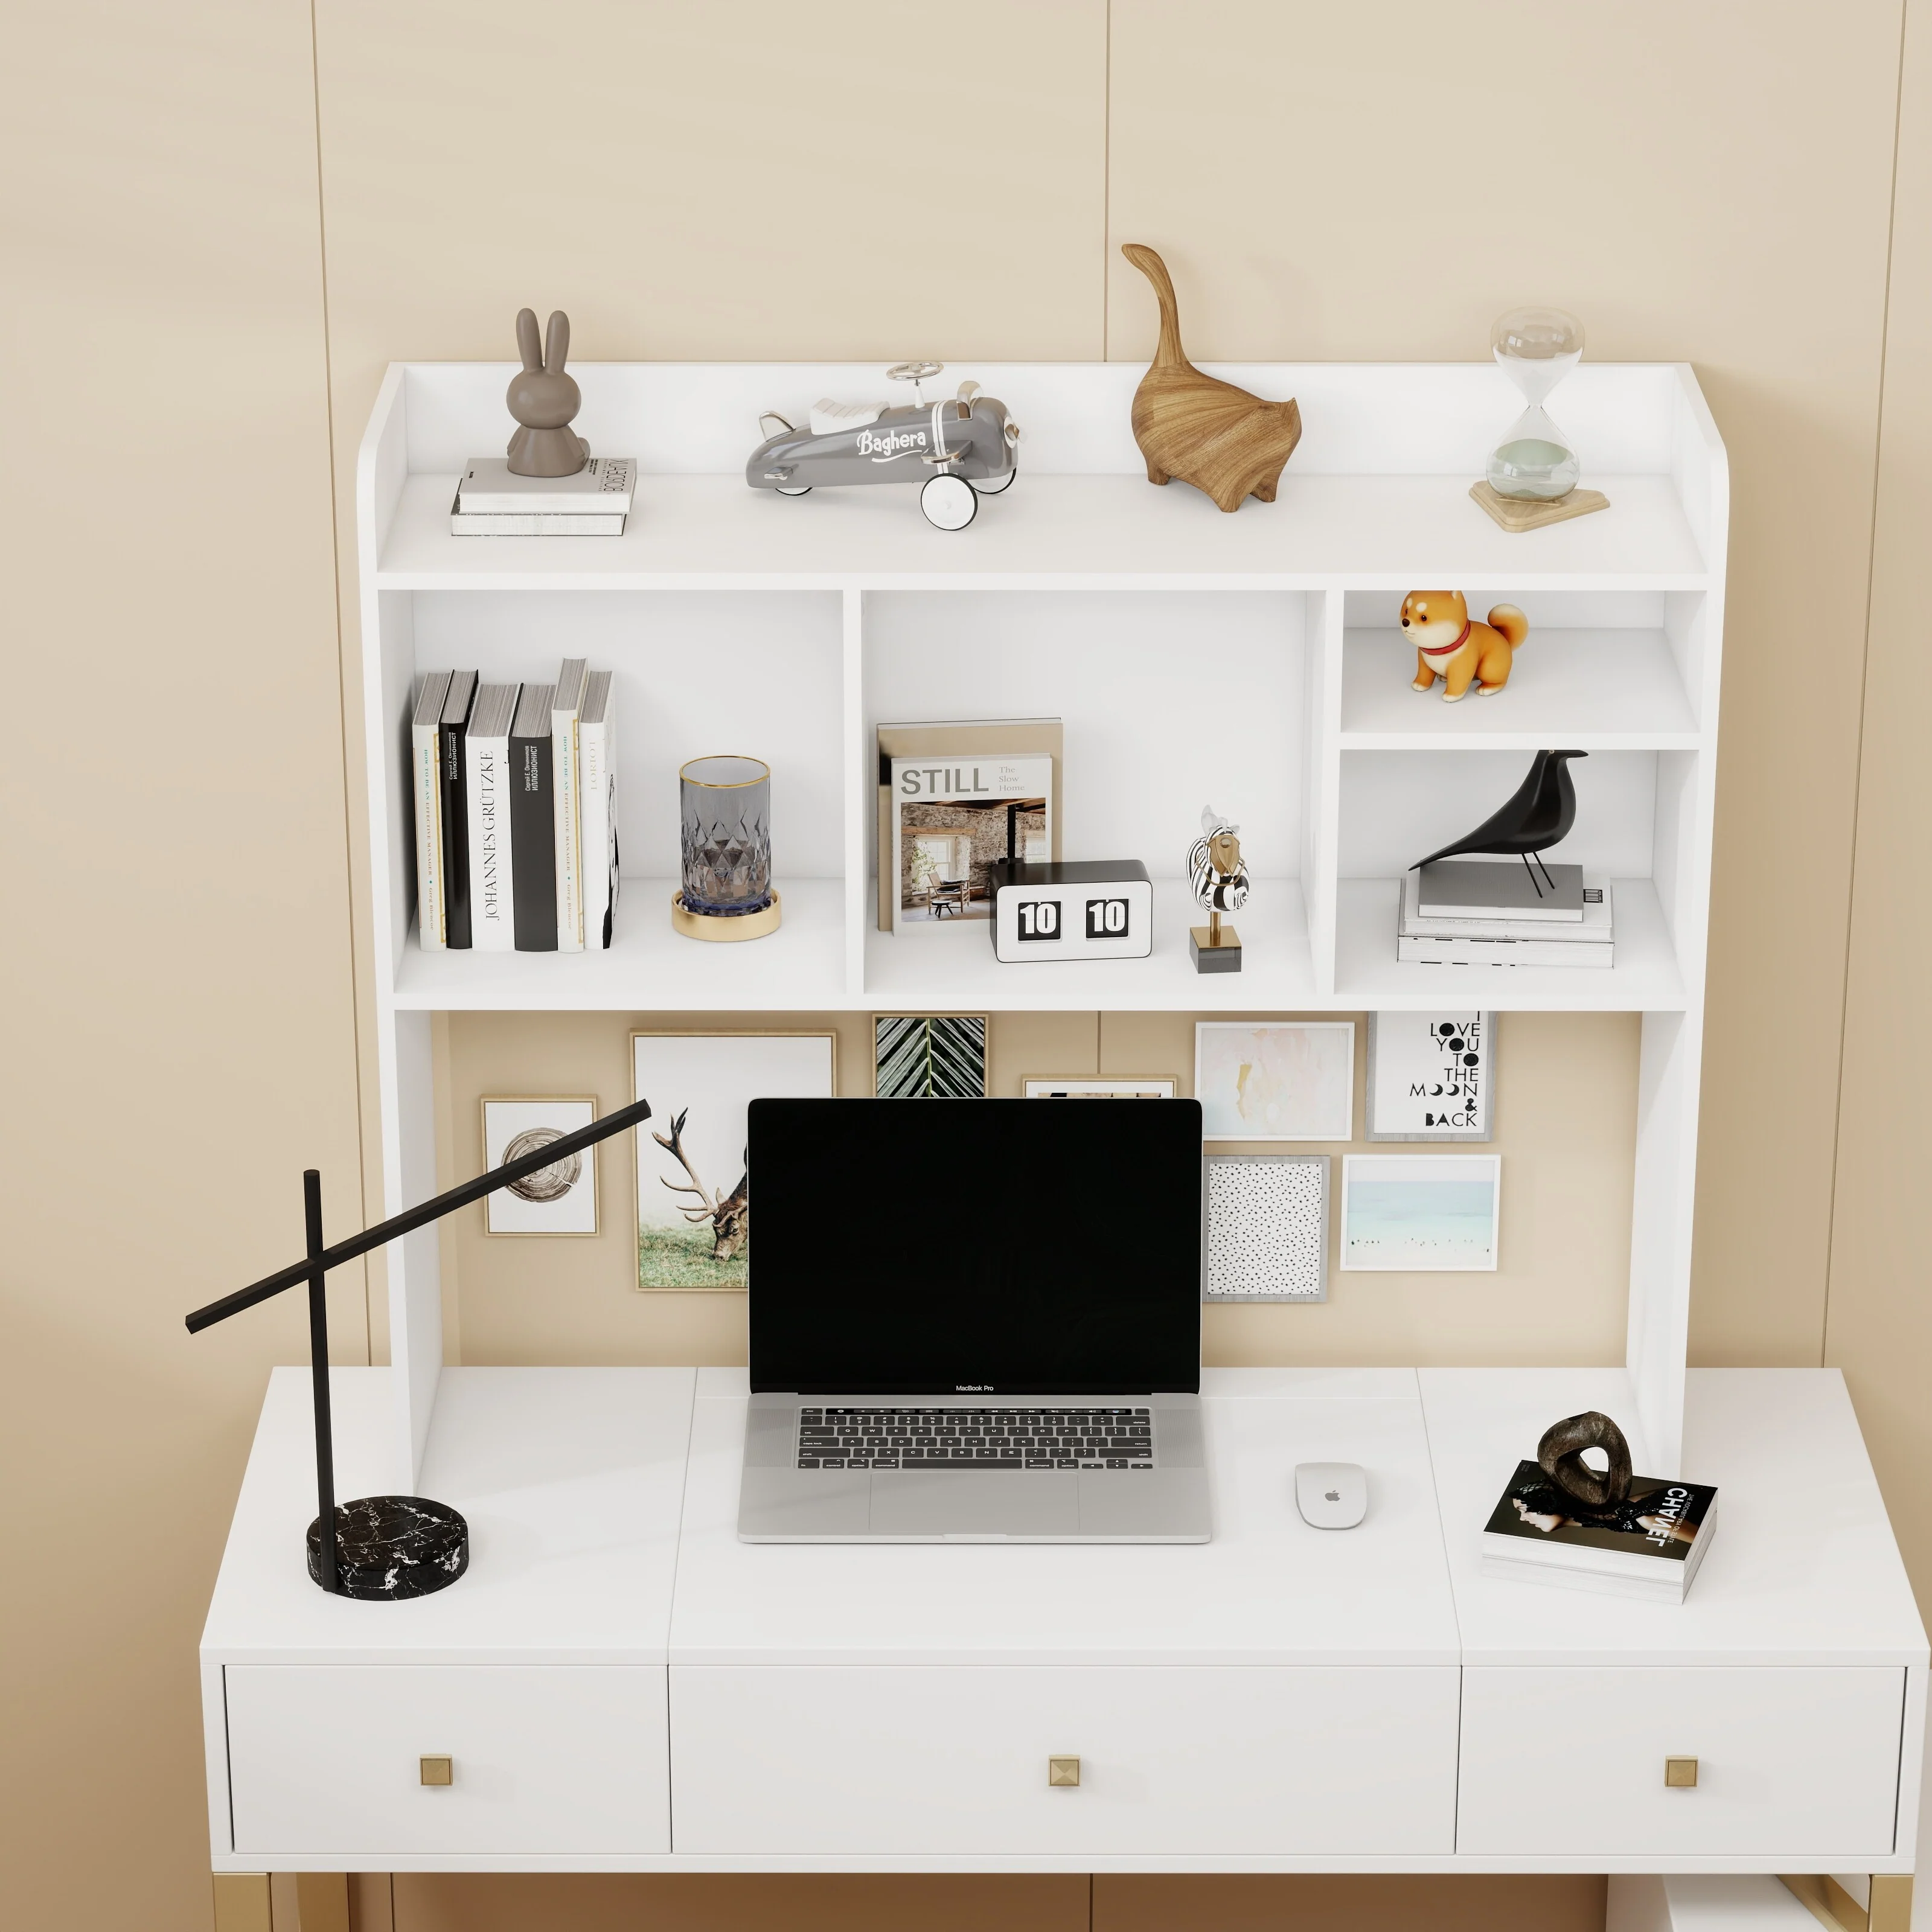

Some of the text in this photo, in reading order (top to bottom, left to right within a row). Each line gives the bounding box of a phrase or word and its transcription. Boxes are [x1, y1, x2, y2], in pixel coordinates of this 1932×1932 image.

[857, 429, 926, 456] Baghera
[564, 756, 568, 766] TO
[425, 768, 429, 778] TO
[530, 745, 539, 791] ИЛЛЮЗИОНИСТ
[564, 769, 568, 778] BE
[425, 779, 429, 788] BE
[565, 781, 569, 790] AN
[901, 768, 989, 795] STILL
[426, 791, 430, 800] AN
[480, 750, 500, 920] JOHANNES GRÜTZKE
[1020, 901, 1125, 933] 10 10
[1430, 1023, 1480, 1037] LOVE
[1436, 1038, 1479, 1051] YOU
[1453, 1053, 1479, 1067] TO
[1444, 1068, 1479, 1081] THE
[1410, 1083, 1477, 1096] MOON
[1465, 1098, 1477, 1112] &
[1425, 1113, 1477, 1127] BACK
